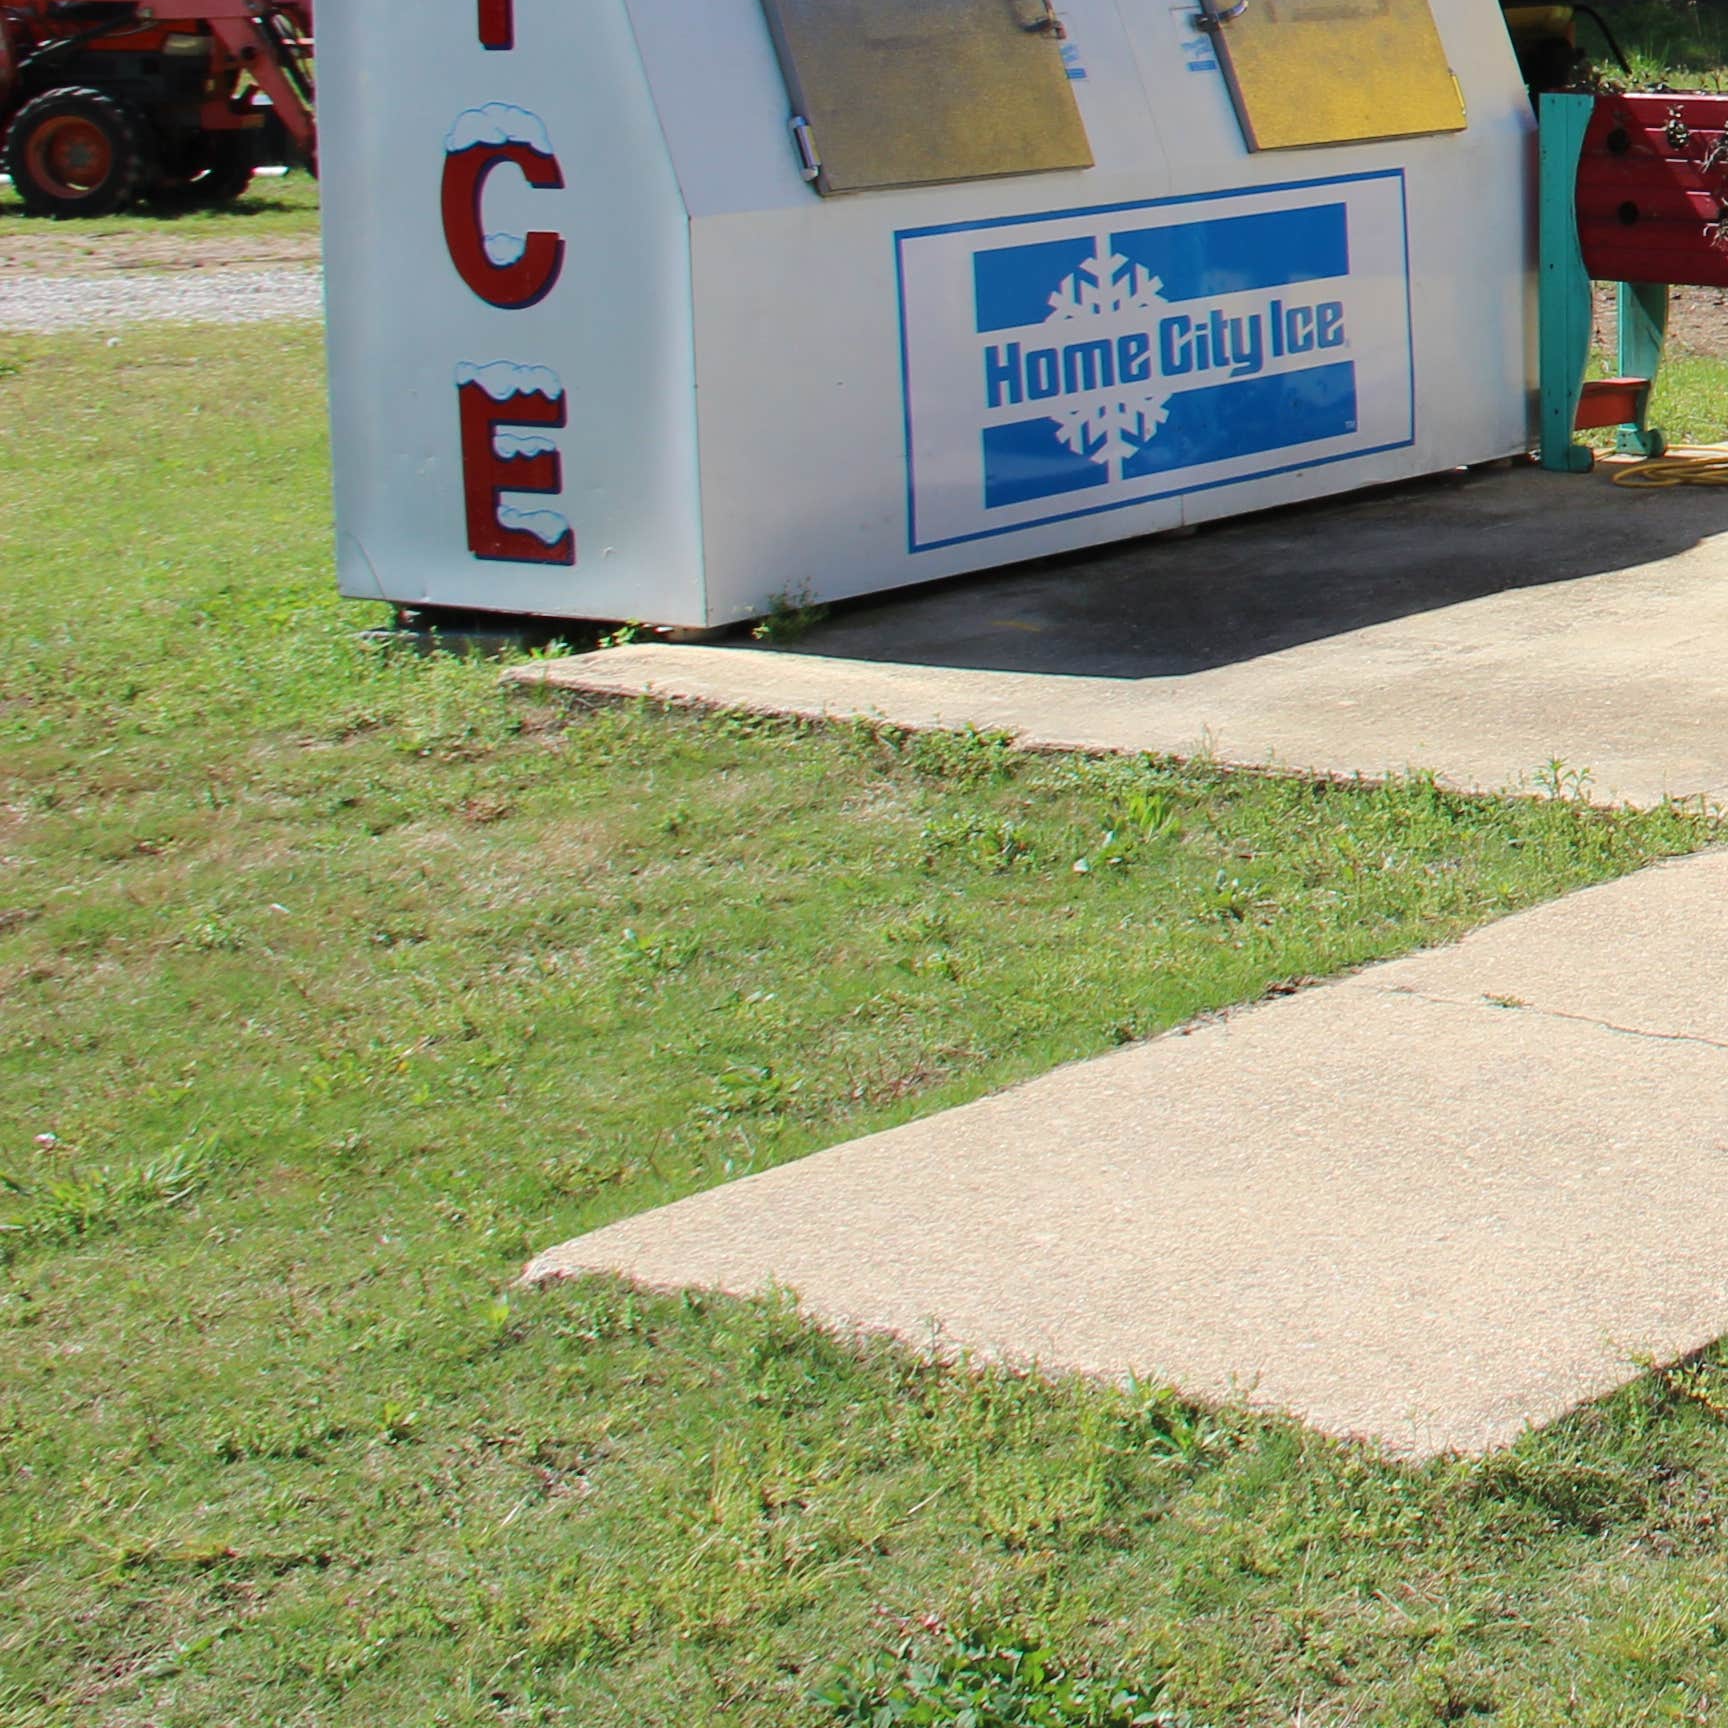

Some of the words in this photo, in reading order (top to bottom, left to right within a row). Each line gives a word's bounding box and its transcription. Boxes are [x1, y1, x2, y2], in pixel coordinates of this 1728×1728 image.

[985, 332, 1153, 408] Home
[1159, 309, 1264, 378] City
[1270, 299, 1346, 357] Ice
